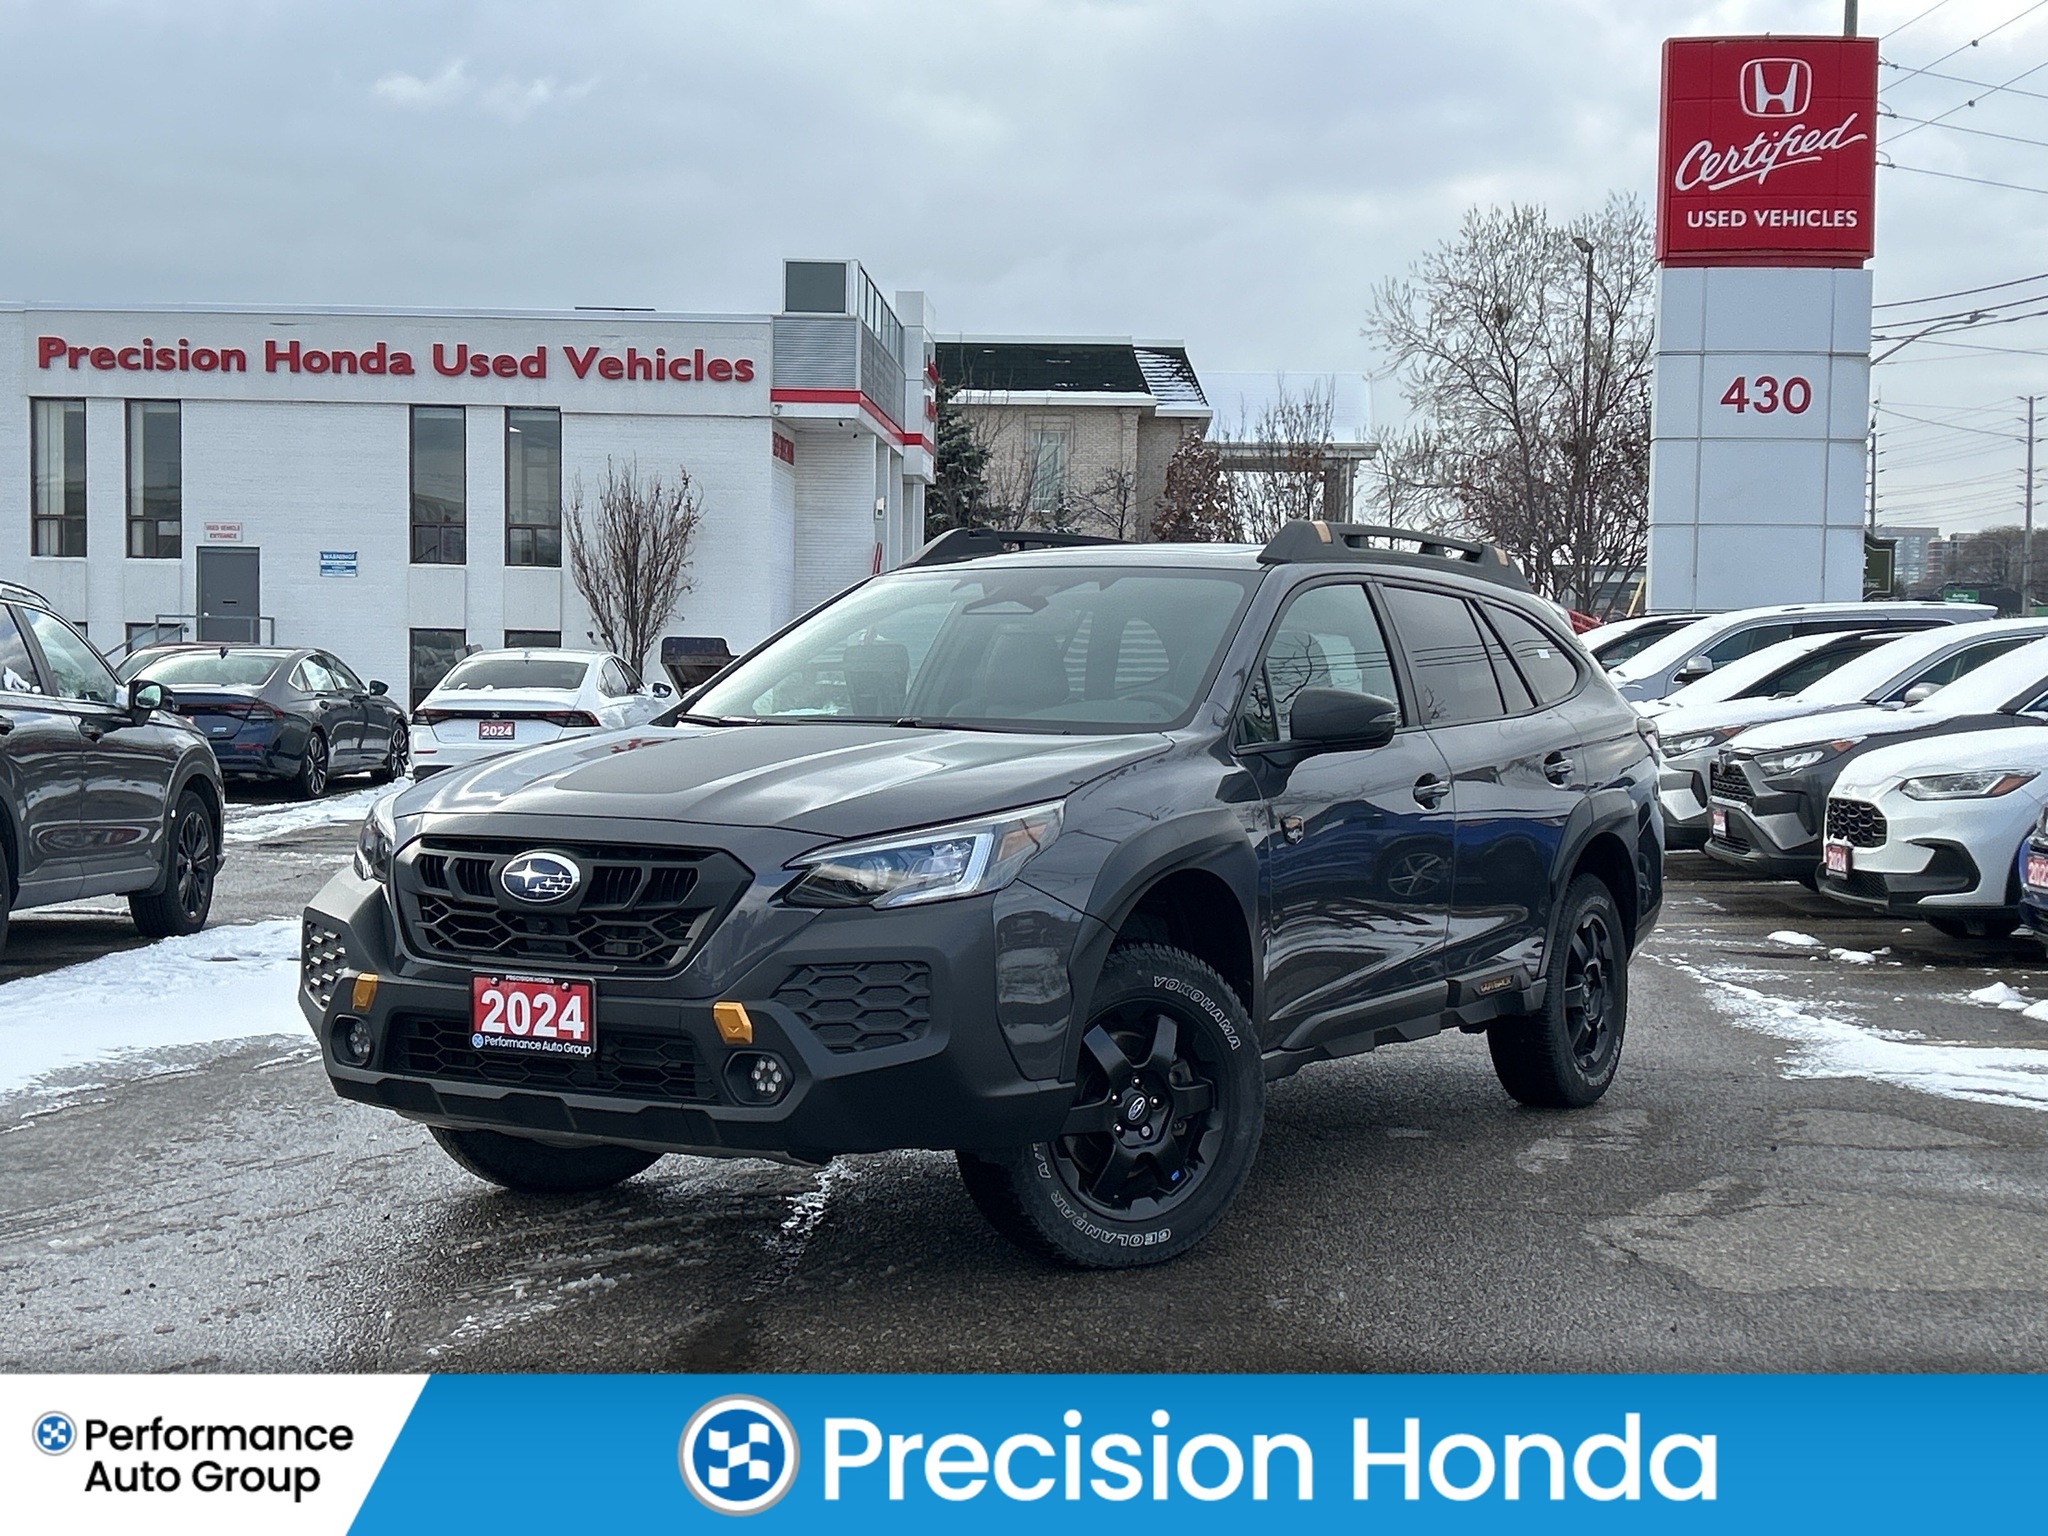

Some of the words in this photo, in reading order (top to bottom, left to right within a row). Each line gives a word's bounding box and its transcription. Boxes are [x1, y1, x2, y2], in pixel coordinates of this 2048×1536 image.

[1675, 113, 1868, 191] Certified
[1687, 210, 1747, 228] USED
[1754, 209, 1858, 228] VEHICLES
[37, 336, 246, 372] Precision
[264, 340, 415, 375] Honda
[432, 343, 547, 379] Used
[563, 346, 755, 383] Vehicles
[1720, 376, 1811, 414] 430
[481, 725, 513, 737] 2024
[481, 989, 585, 1040] 2024
[1153, 975, 1241, 1050] YOKOHAMA
[484, 1035, 541, 1051] Performance
[542, 1040, 562, 1053] Auto
[563, 1042, 591, 1058] Group
[1050, 1190, 1172, 1247] GEOLANDAR
